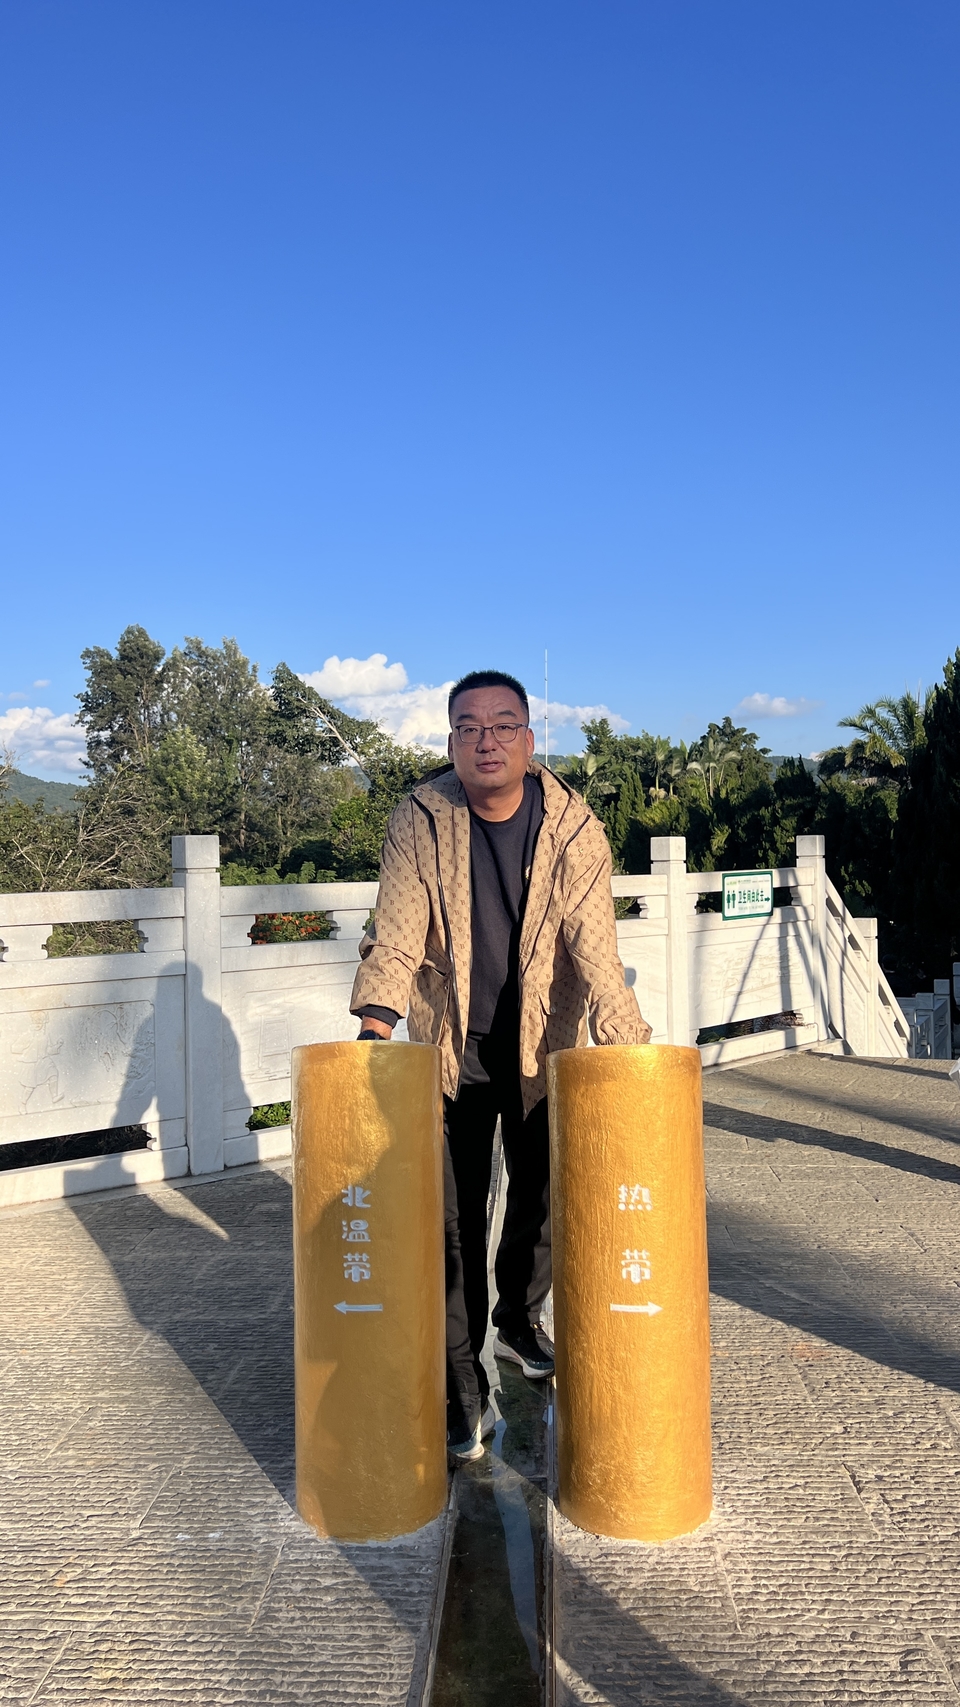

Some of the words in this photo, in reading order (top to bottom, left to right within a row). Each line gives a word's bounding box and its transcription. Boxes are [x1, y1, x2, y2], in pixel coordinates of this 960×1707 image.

[341, 1184, 371, 1283] 北温带
[618, 1183, 652, 1284] 热带
